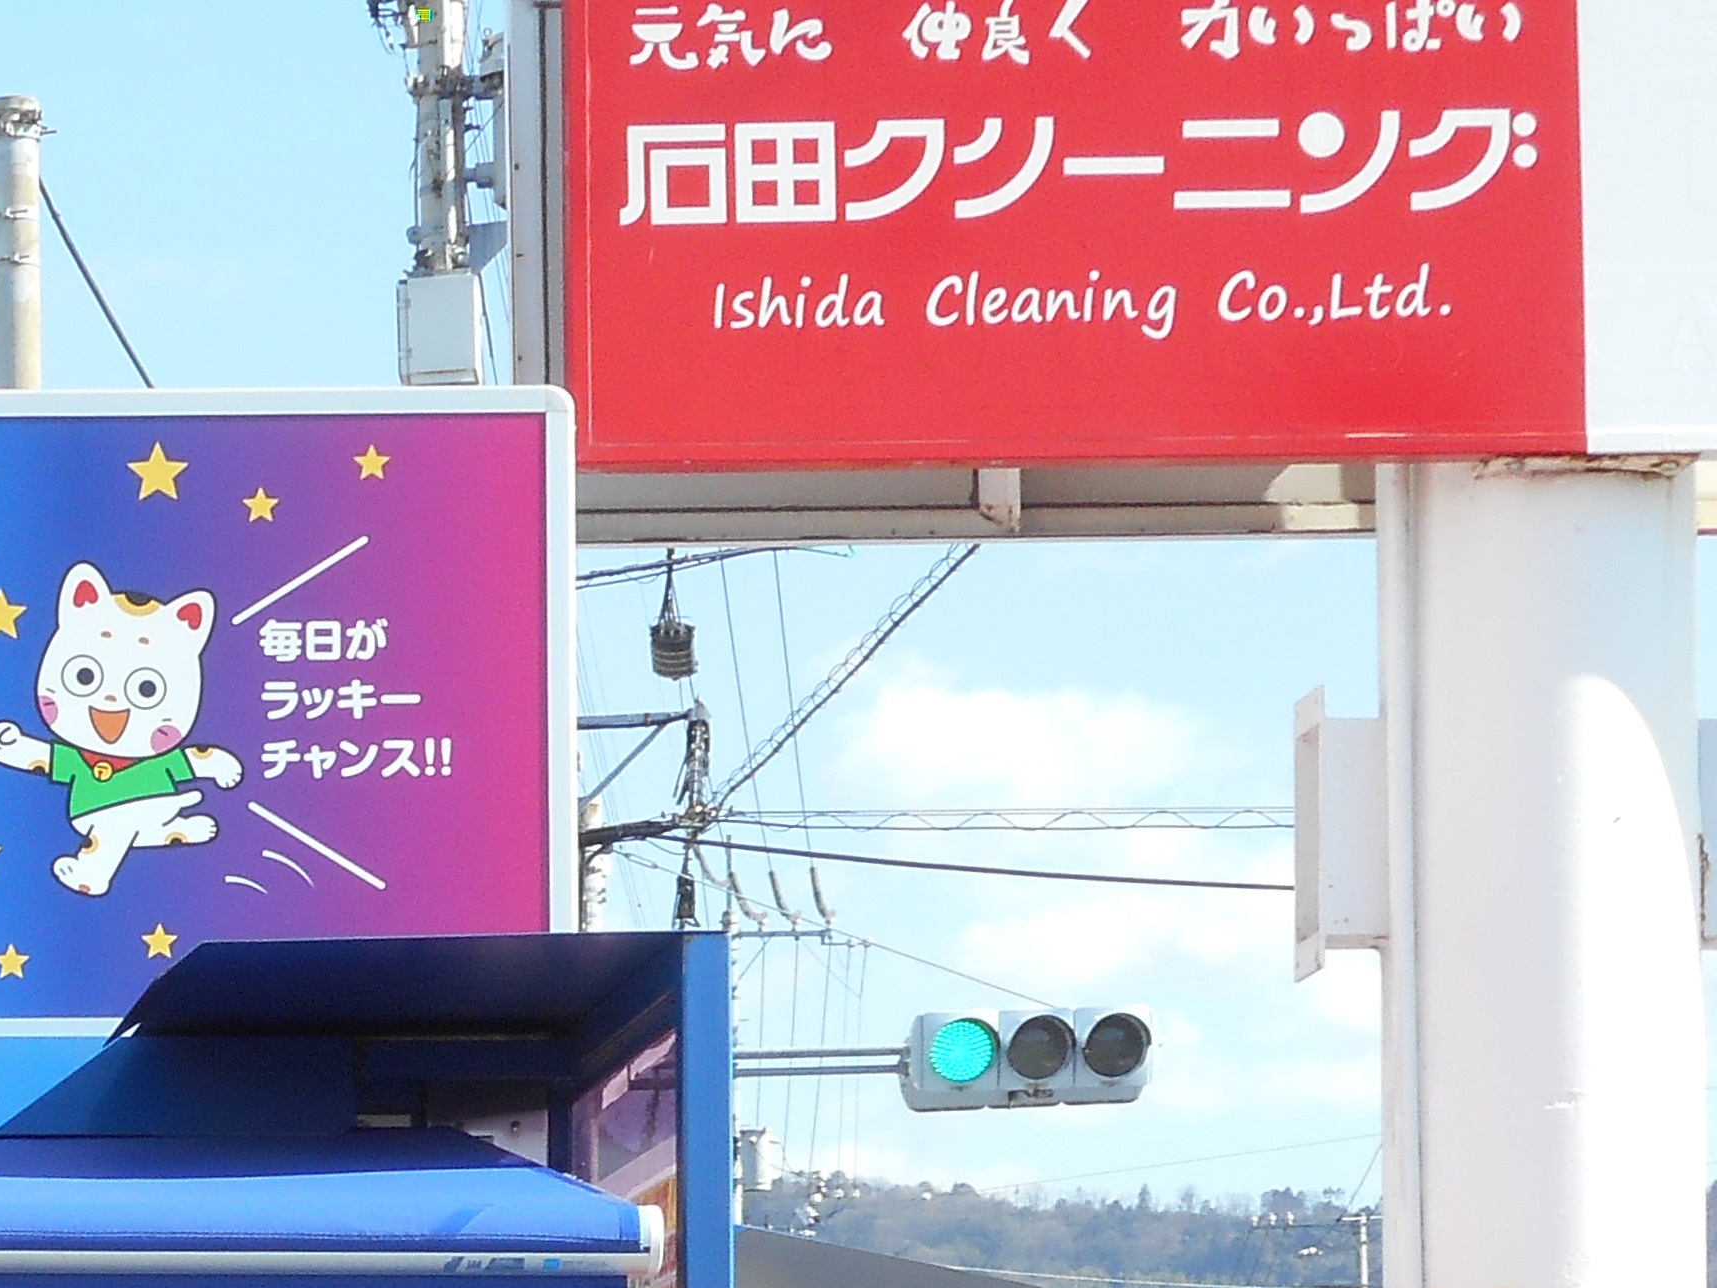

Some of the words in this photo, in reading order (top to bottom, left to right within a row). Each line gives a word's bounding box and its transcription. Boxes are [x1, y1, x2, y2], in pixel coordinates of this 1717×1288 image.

[629, 5, 833, 72] 元気に
[620, 108, 1539, 226] 石田クリーニング
[713, 281, 885, 329] Ishida
[926, 272, 1176, 340] Cleaning
[1219, 262, 1454, 326] Co.,Ltd.
[259, 618, 389, 662] 毎日が
[260, 680, 422, 720] ラッキー
